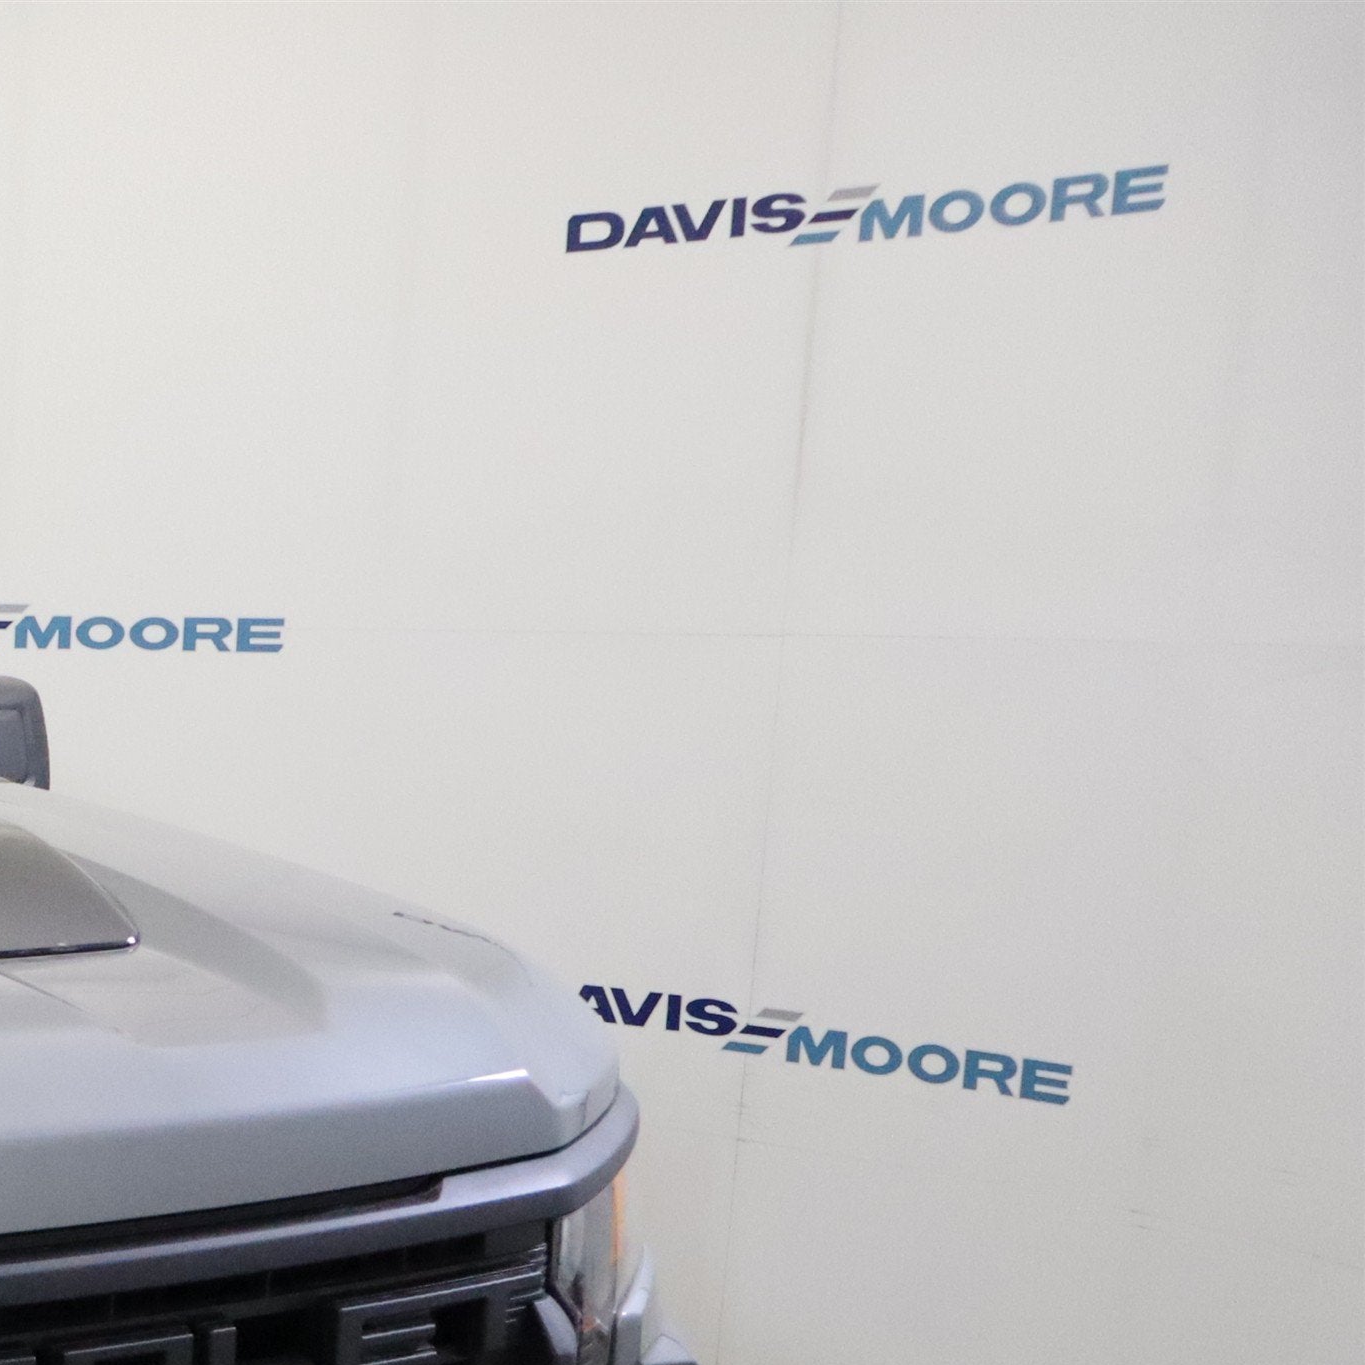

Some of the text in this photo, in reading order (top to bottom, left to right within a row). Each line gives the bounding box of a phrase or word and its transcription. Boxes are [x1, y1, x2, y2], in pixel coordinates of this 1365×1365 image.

[565, 163, 1169, 253] DAVIS MOORE
[14, 615, 285, 652] MOORE
[578, 984, 1073, 1106] AVIS MOORE
